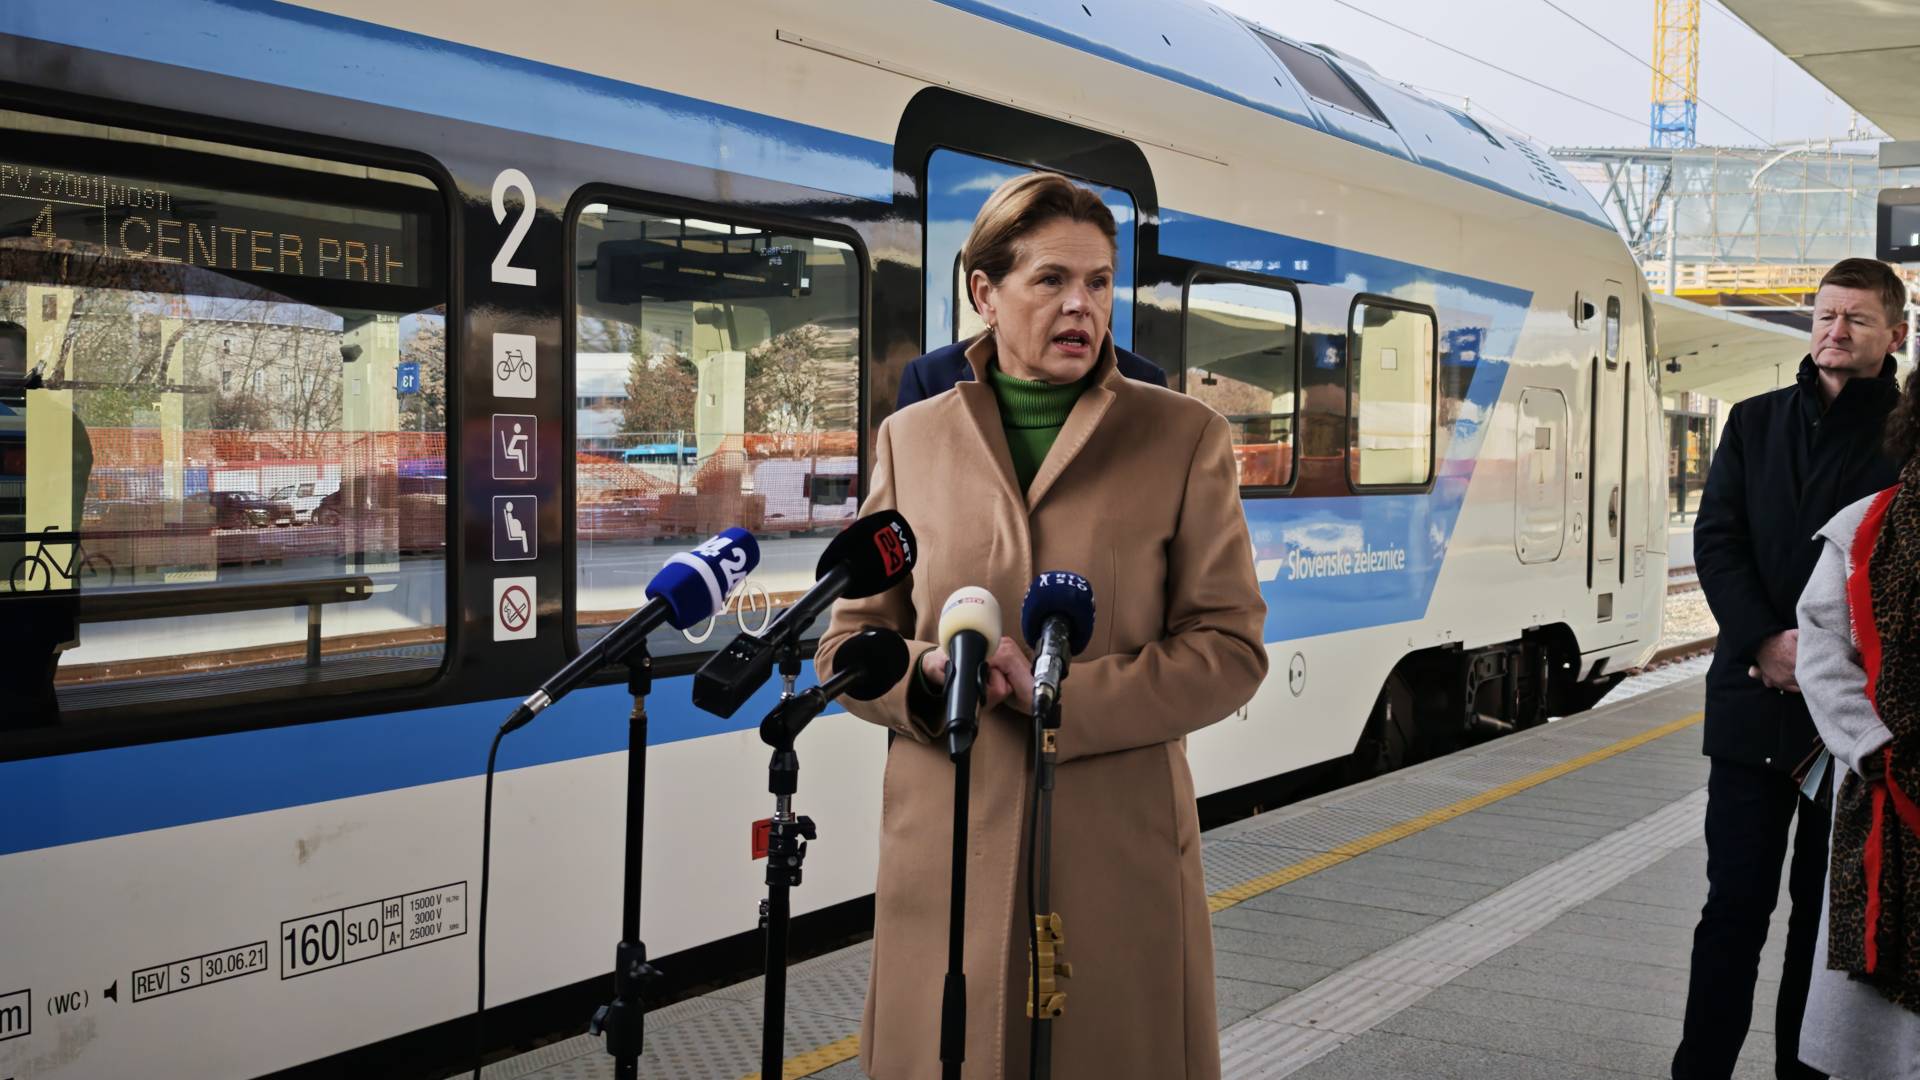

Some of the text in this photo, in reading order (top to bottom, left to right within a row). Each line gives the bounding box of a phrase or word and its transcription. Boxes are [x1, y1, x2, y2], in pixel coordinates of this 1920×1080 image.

[1, 165, 99, 200] PV 37001
[32, 203, 57, 248] 4
[491, 168, 537, 287] 2
[120, 216, 304, 275] CENTER
[890, 521, 911, 563] SVET
[1287, 547, 1351, 581] Slovenske
[385, 903, 400, 920] HR
[410, 896, 435, 911] 15000
[436, 893, 442, 906] V
[415, 907, 442, 925] 3000 V
[284, 919, 340, 969] 160
[347, 918, 379, 946] SLO
[409, 923, 436, 941] 25000
[436, 921, 442, 934] V
[180, 965, 190, 984] S
[205, 948, 263, 978] 30.06.21
[137, 971, 165, 995] REV
[47, 989, 89, 1016] (WC)
